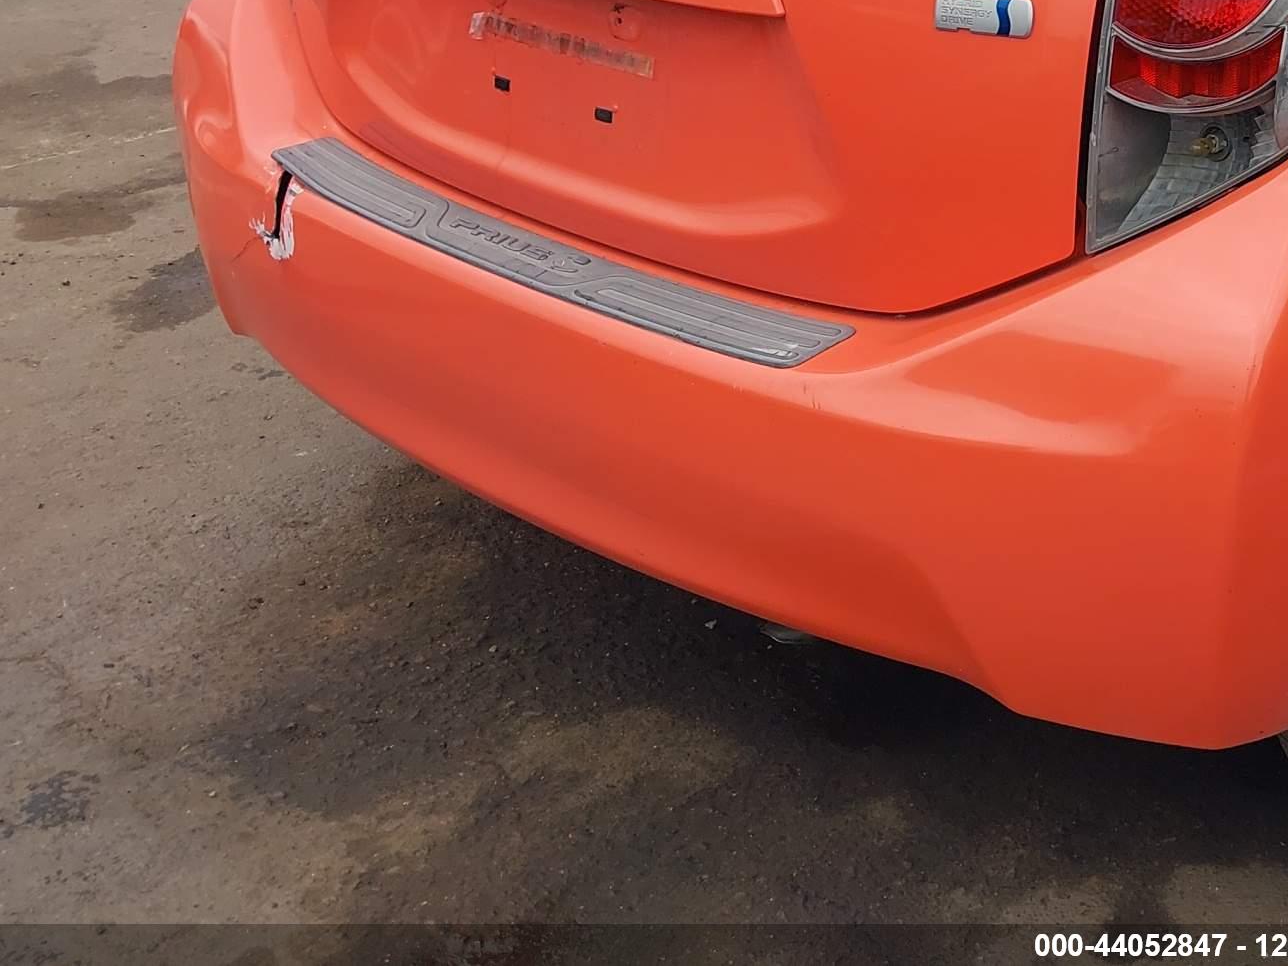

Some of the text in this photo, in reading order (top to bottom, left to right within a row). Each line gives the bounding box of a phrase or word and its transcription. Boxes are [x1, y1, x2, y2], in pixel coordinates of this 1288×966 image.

[941, 6, 993, 18] SYNERGY
[941, 15, 974, 26] DRIVE
[449, 217, 554, 261] PRIUS
